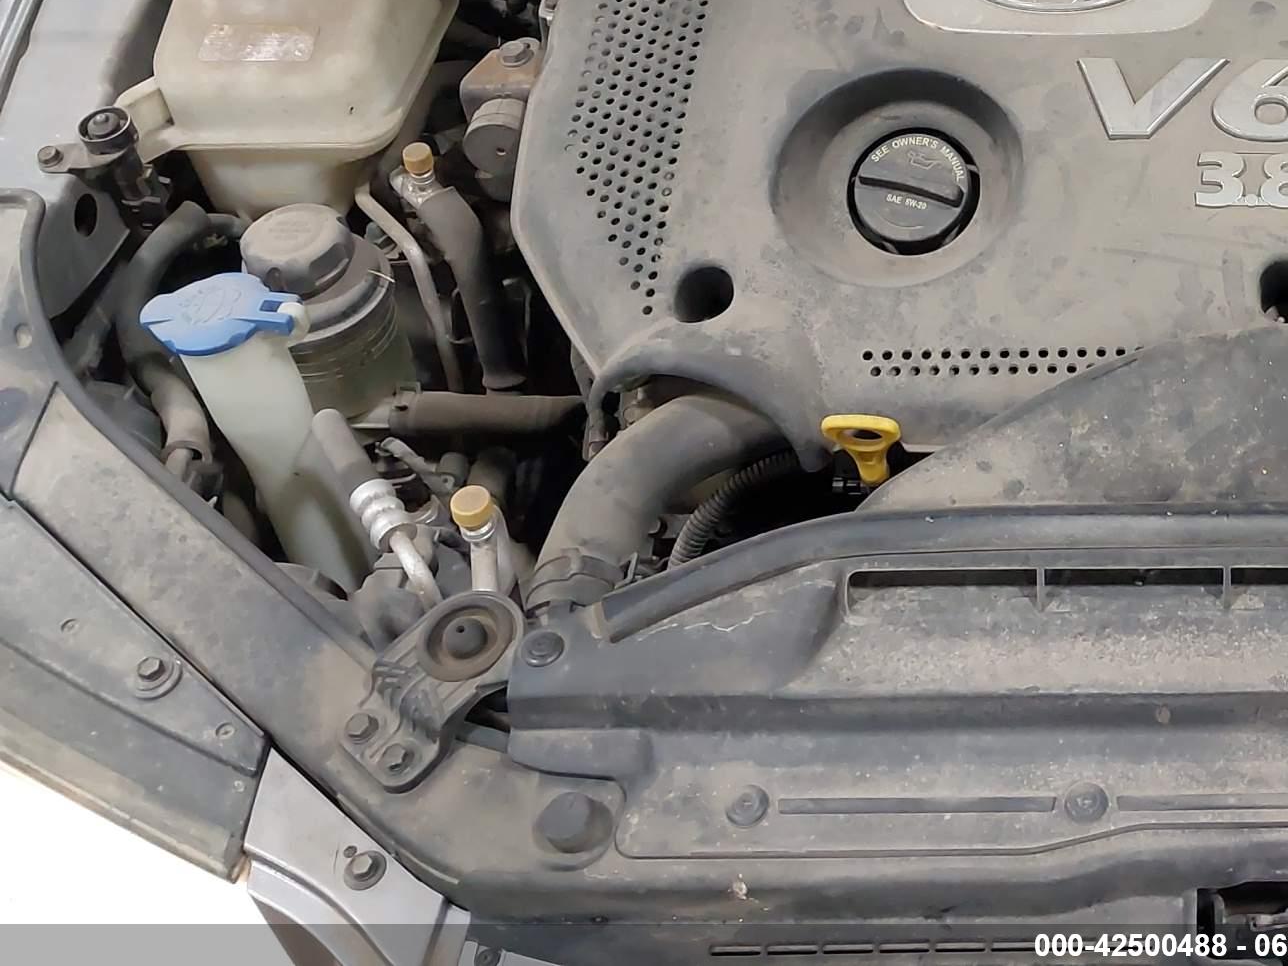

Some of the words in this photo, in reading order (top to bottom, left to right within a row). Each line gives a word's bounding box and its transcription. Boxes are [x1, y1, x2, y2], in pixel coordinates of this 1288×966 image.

[871, 146, 890, 163] SEE
[892, 136, 939, 149] OWNER'S
[940, 146, 966, 183] MANUAL
[886, 194, 902, 204] SAE
[905, 199, 928, 210] 5W-20
